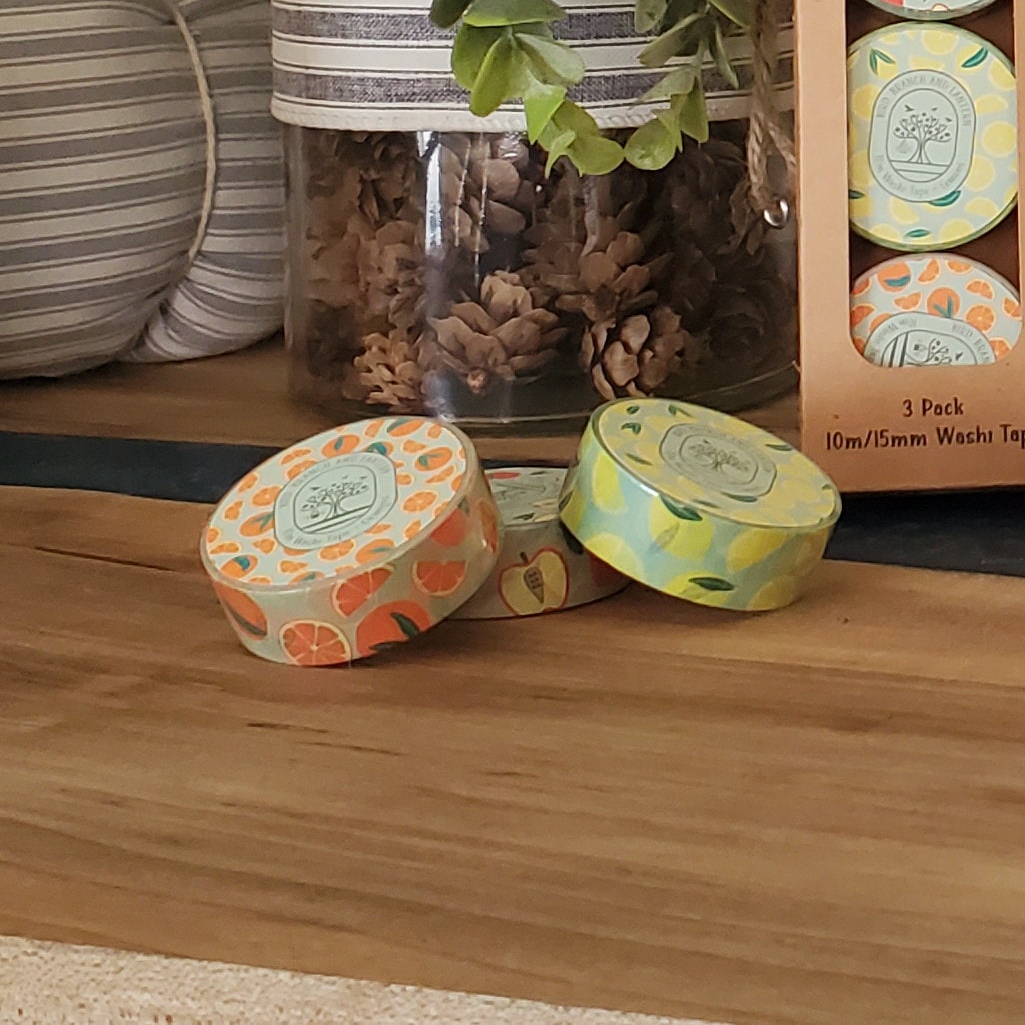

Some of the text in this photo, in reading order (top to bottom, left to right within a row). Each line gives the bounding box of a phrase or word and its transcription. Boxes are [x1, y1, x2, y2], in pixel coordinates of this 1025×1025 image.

[902, 397, 965, 418] 3 Pack
[826, 428, 928, 450] 10m/15mm
[936, 425, 993, 446] Washi
